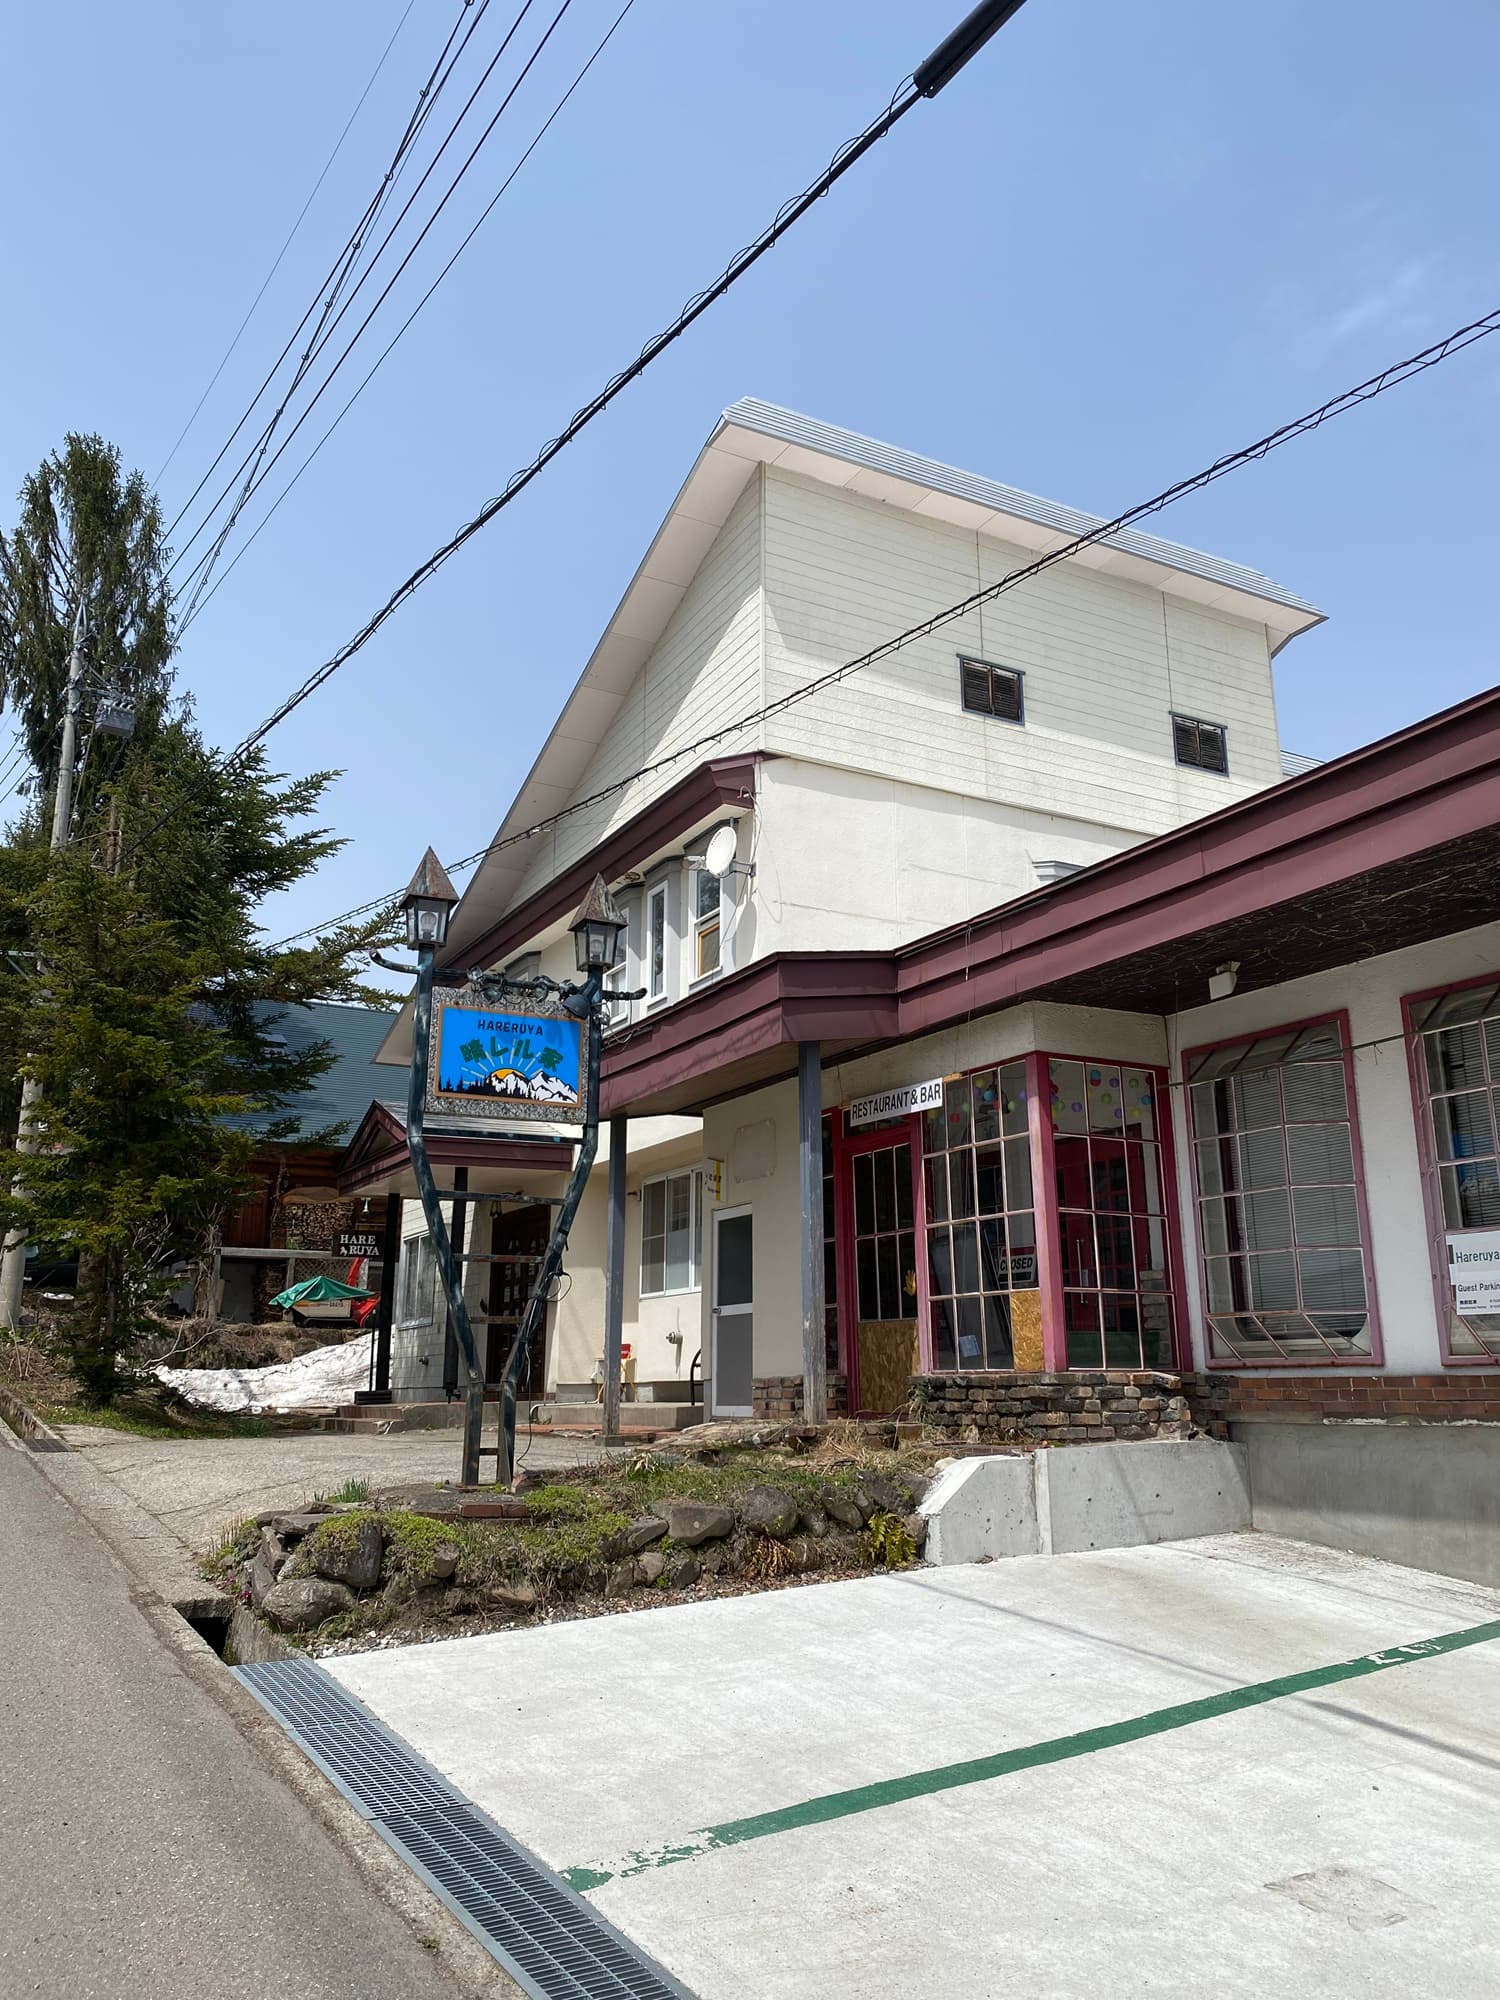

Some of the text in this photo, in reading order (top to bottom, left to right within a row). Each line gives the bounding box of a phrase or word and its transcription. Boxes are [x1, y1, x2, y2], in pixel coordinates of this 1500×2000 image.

[477, 1019, 543, 1036] HARERUYA
[852, 1083, 941, 1120] RESTAURANT & BAR
[340, 1234, 376, 1245] HARE
[348, 1245, 380, 1256] RUYA
[1455, 1250, 1500, 1264] Hareruya
[1457, 1284, 1478, 1293] Guest
